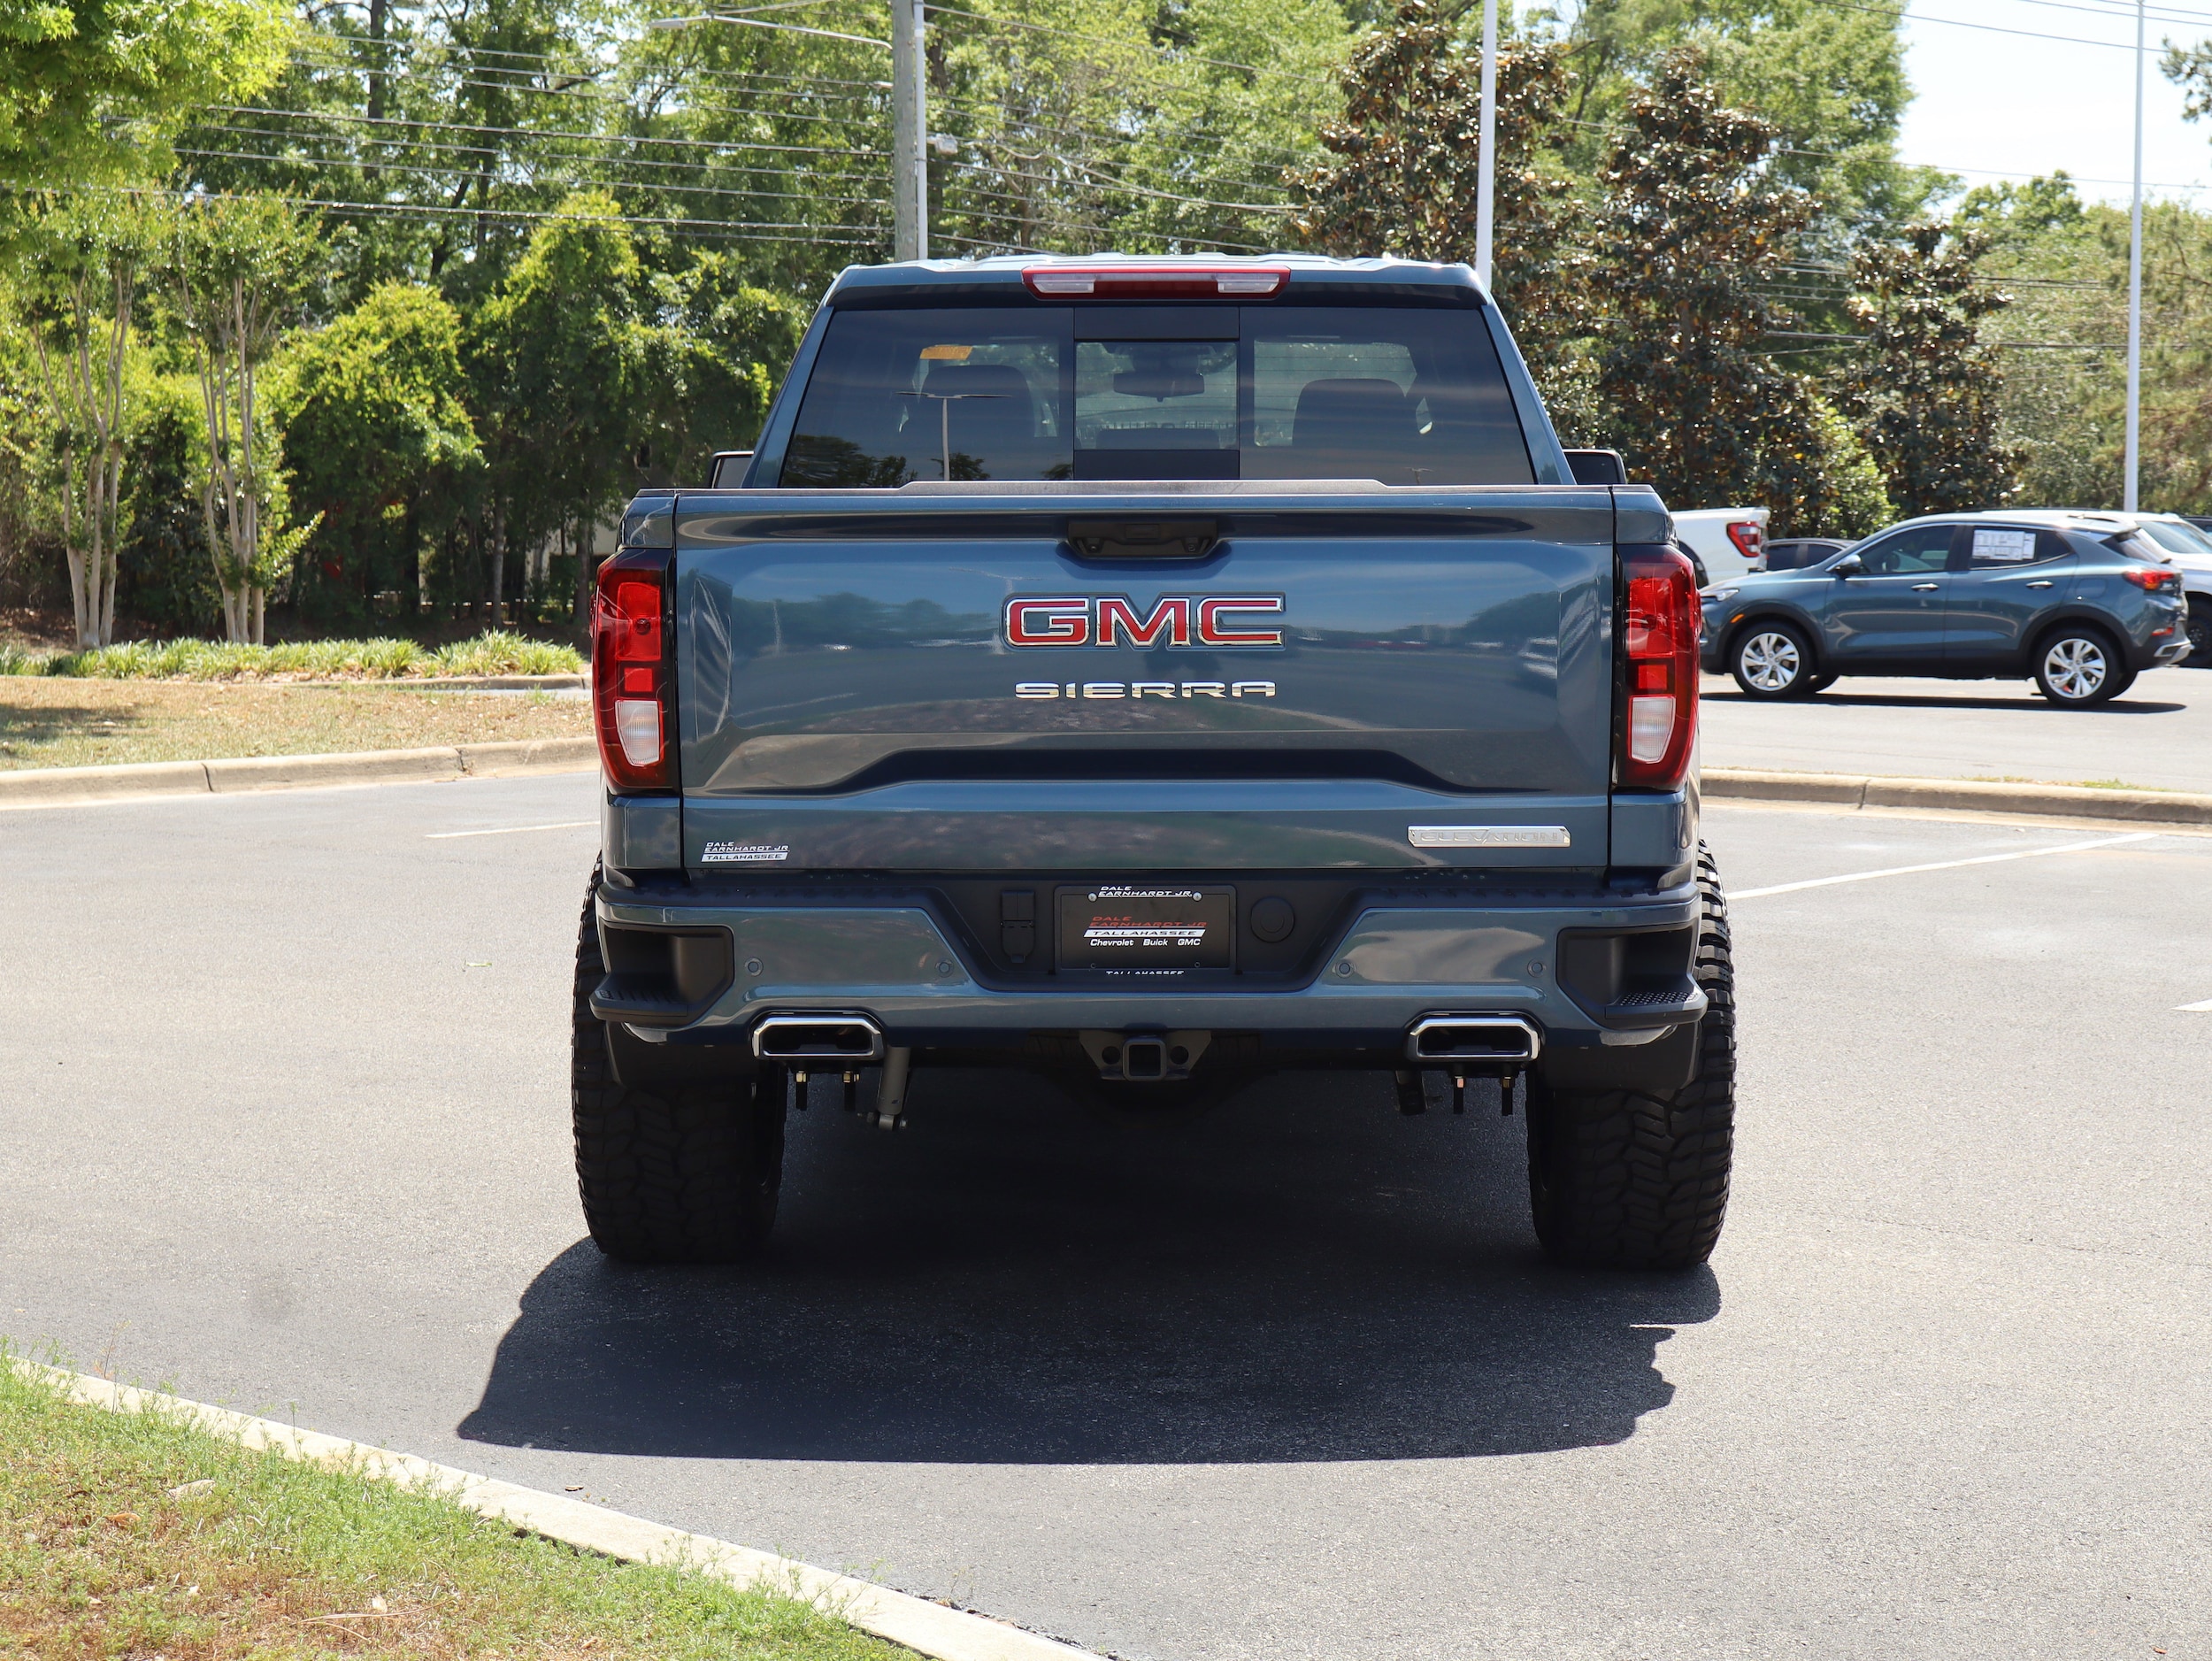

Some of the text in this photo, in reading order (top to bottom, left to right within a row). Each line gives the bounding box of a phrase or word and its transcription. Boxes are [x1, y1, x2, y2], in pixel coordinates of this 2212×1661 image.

[1006, 597, 1282, 647] GMC
[1015, 681, 1276, 699] SIERRA
[1090, 938, 1134, 947] Chevrolet
